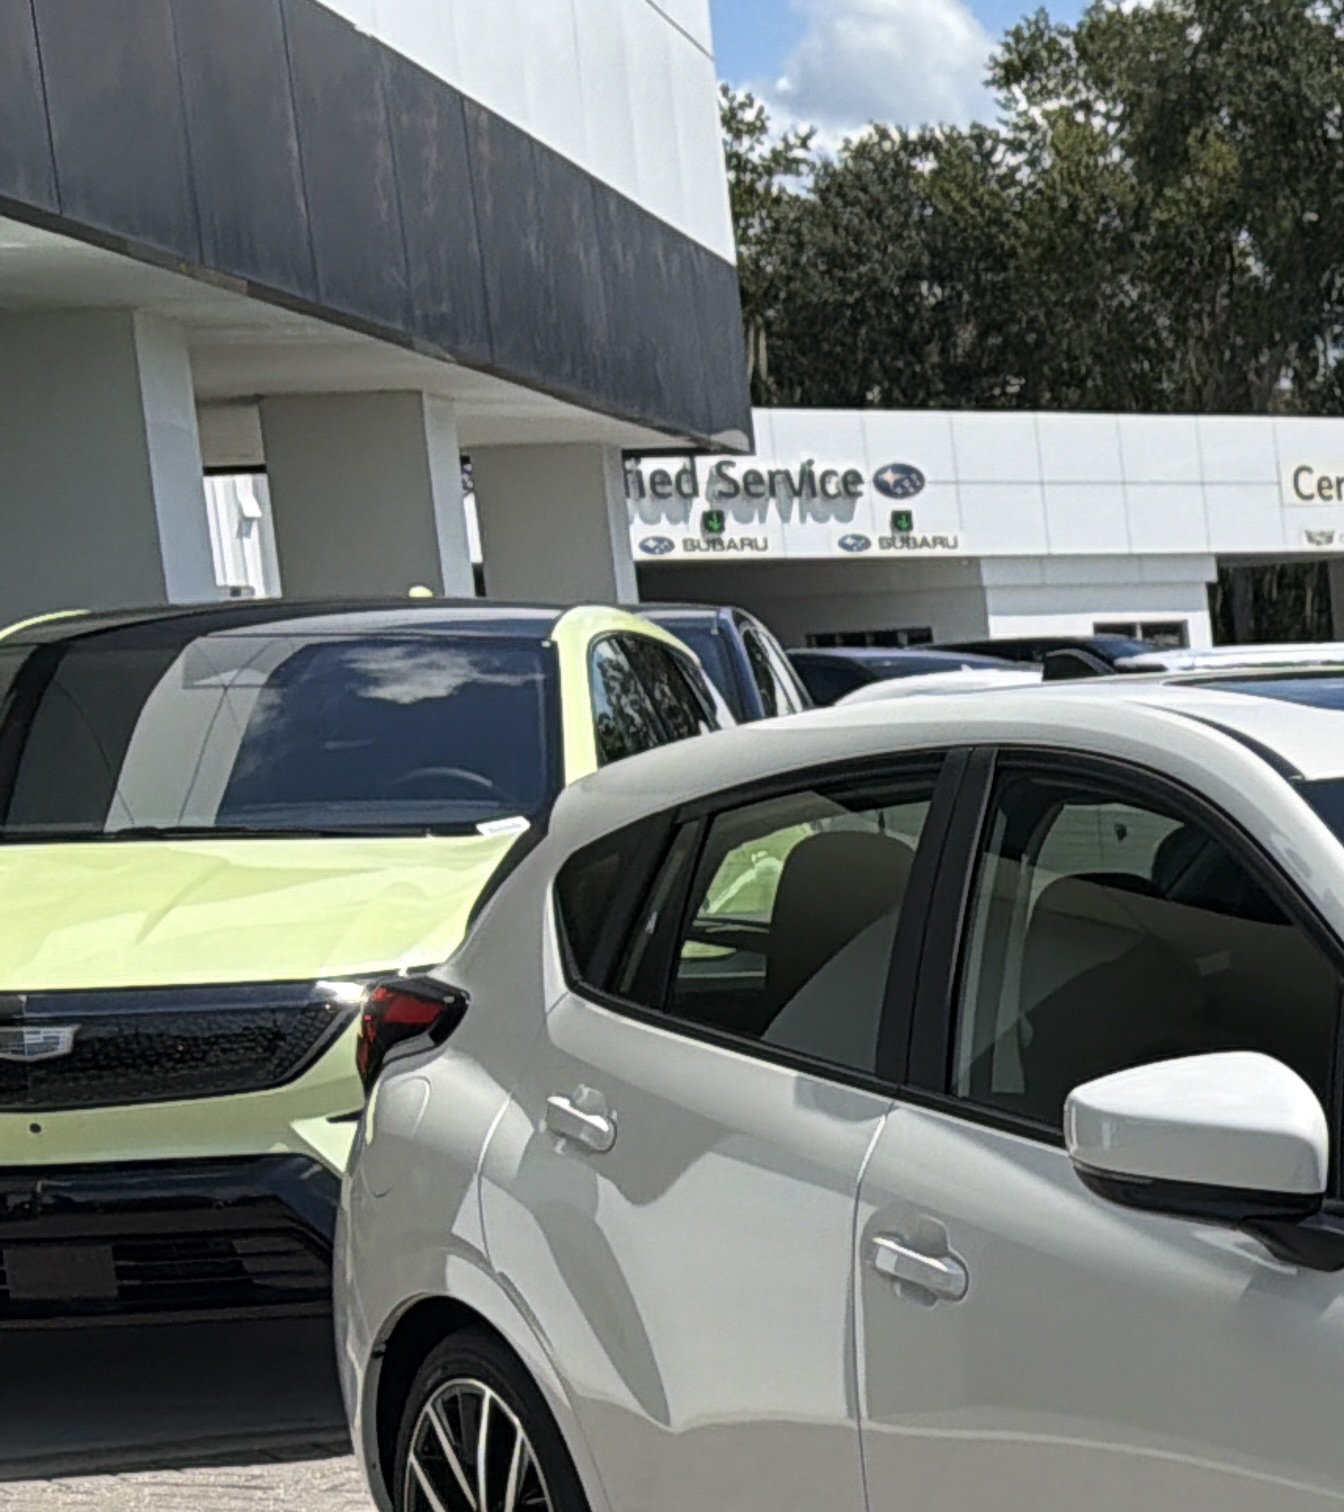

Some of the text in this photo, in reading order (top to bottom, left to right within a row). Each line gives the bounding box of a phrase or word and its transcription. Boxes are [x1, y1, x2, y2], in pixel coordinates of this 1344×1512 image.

[715, 459, 864, 500] Service
[682, 536, 769, 552] SUBARU
[878, 536, 959, 550] SUBARU
